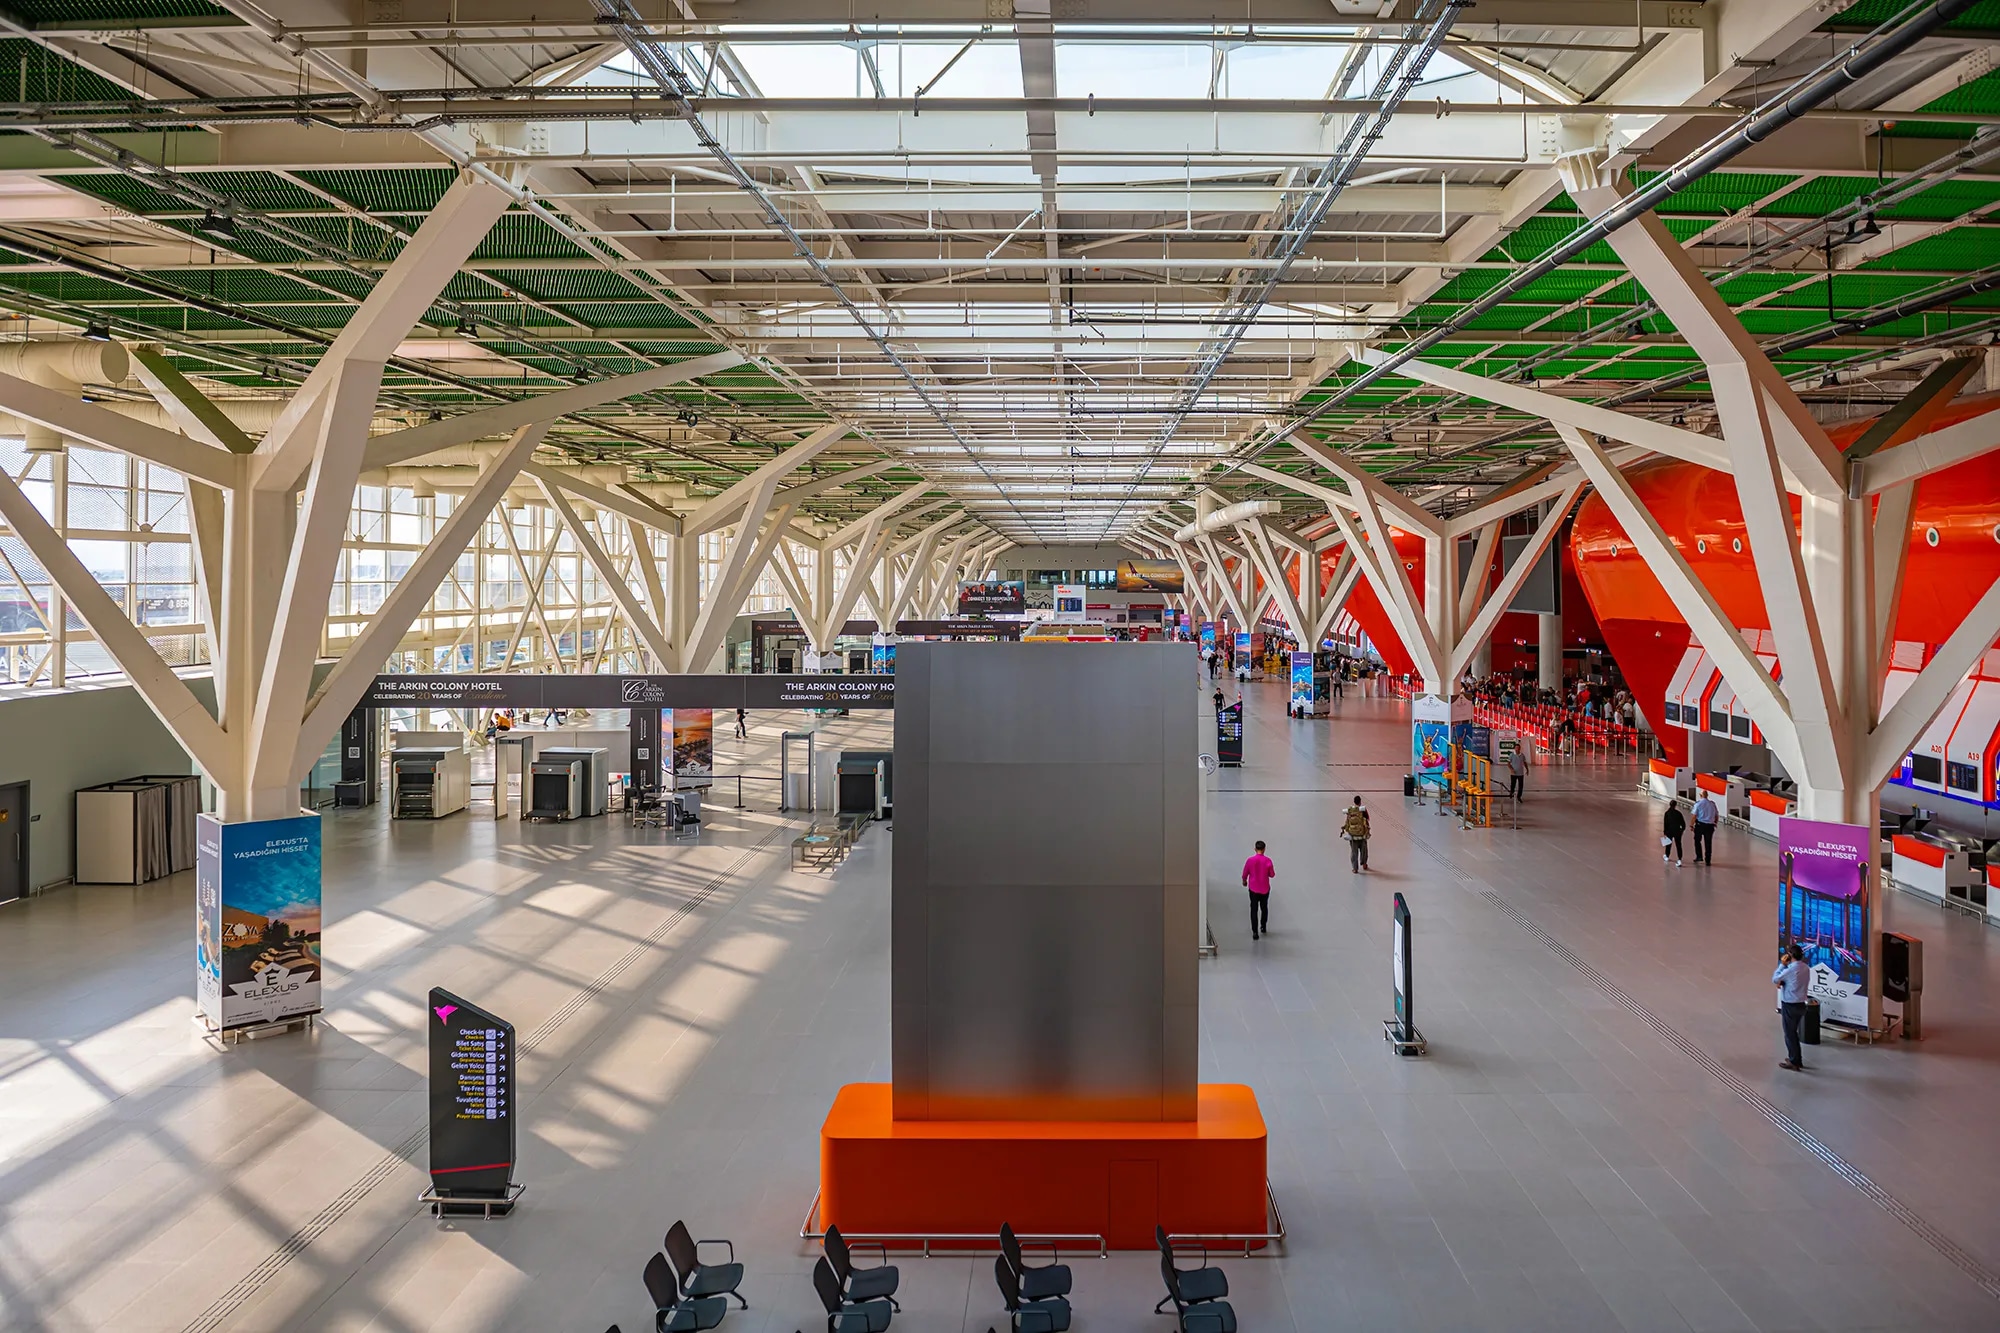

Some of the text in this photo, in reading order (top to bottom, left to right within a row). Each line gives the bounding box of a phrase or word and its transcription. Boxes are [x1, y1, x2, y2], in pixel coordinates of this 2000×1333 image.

[417, 692, 430, 700] 20
[1931, 745, 1942, 753] A20
[1968, 752, 1979, 760] A19
[266, 837, 308, 847] ELEXUS'TA
[1817, 842, 1857, 852] ELEXUS'TA
[244, 983, 299, 999] ELEXUS
